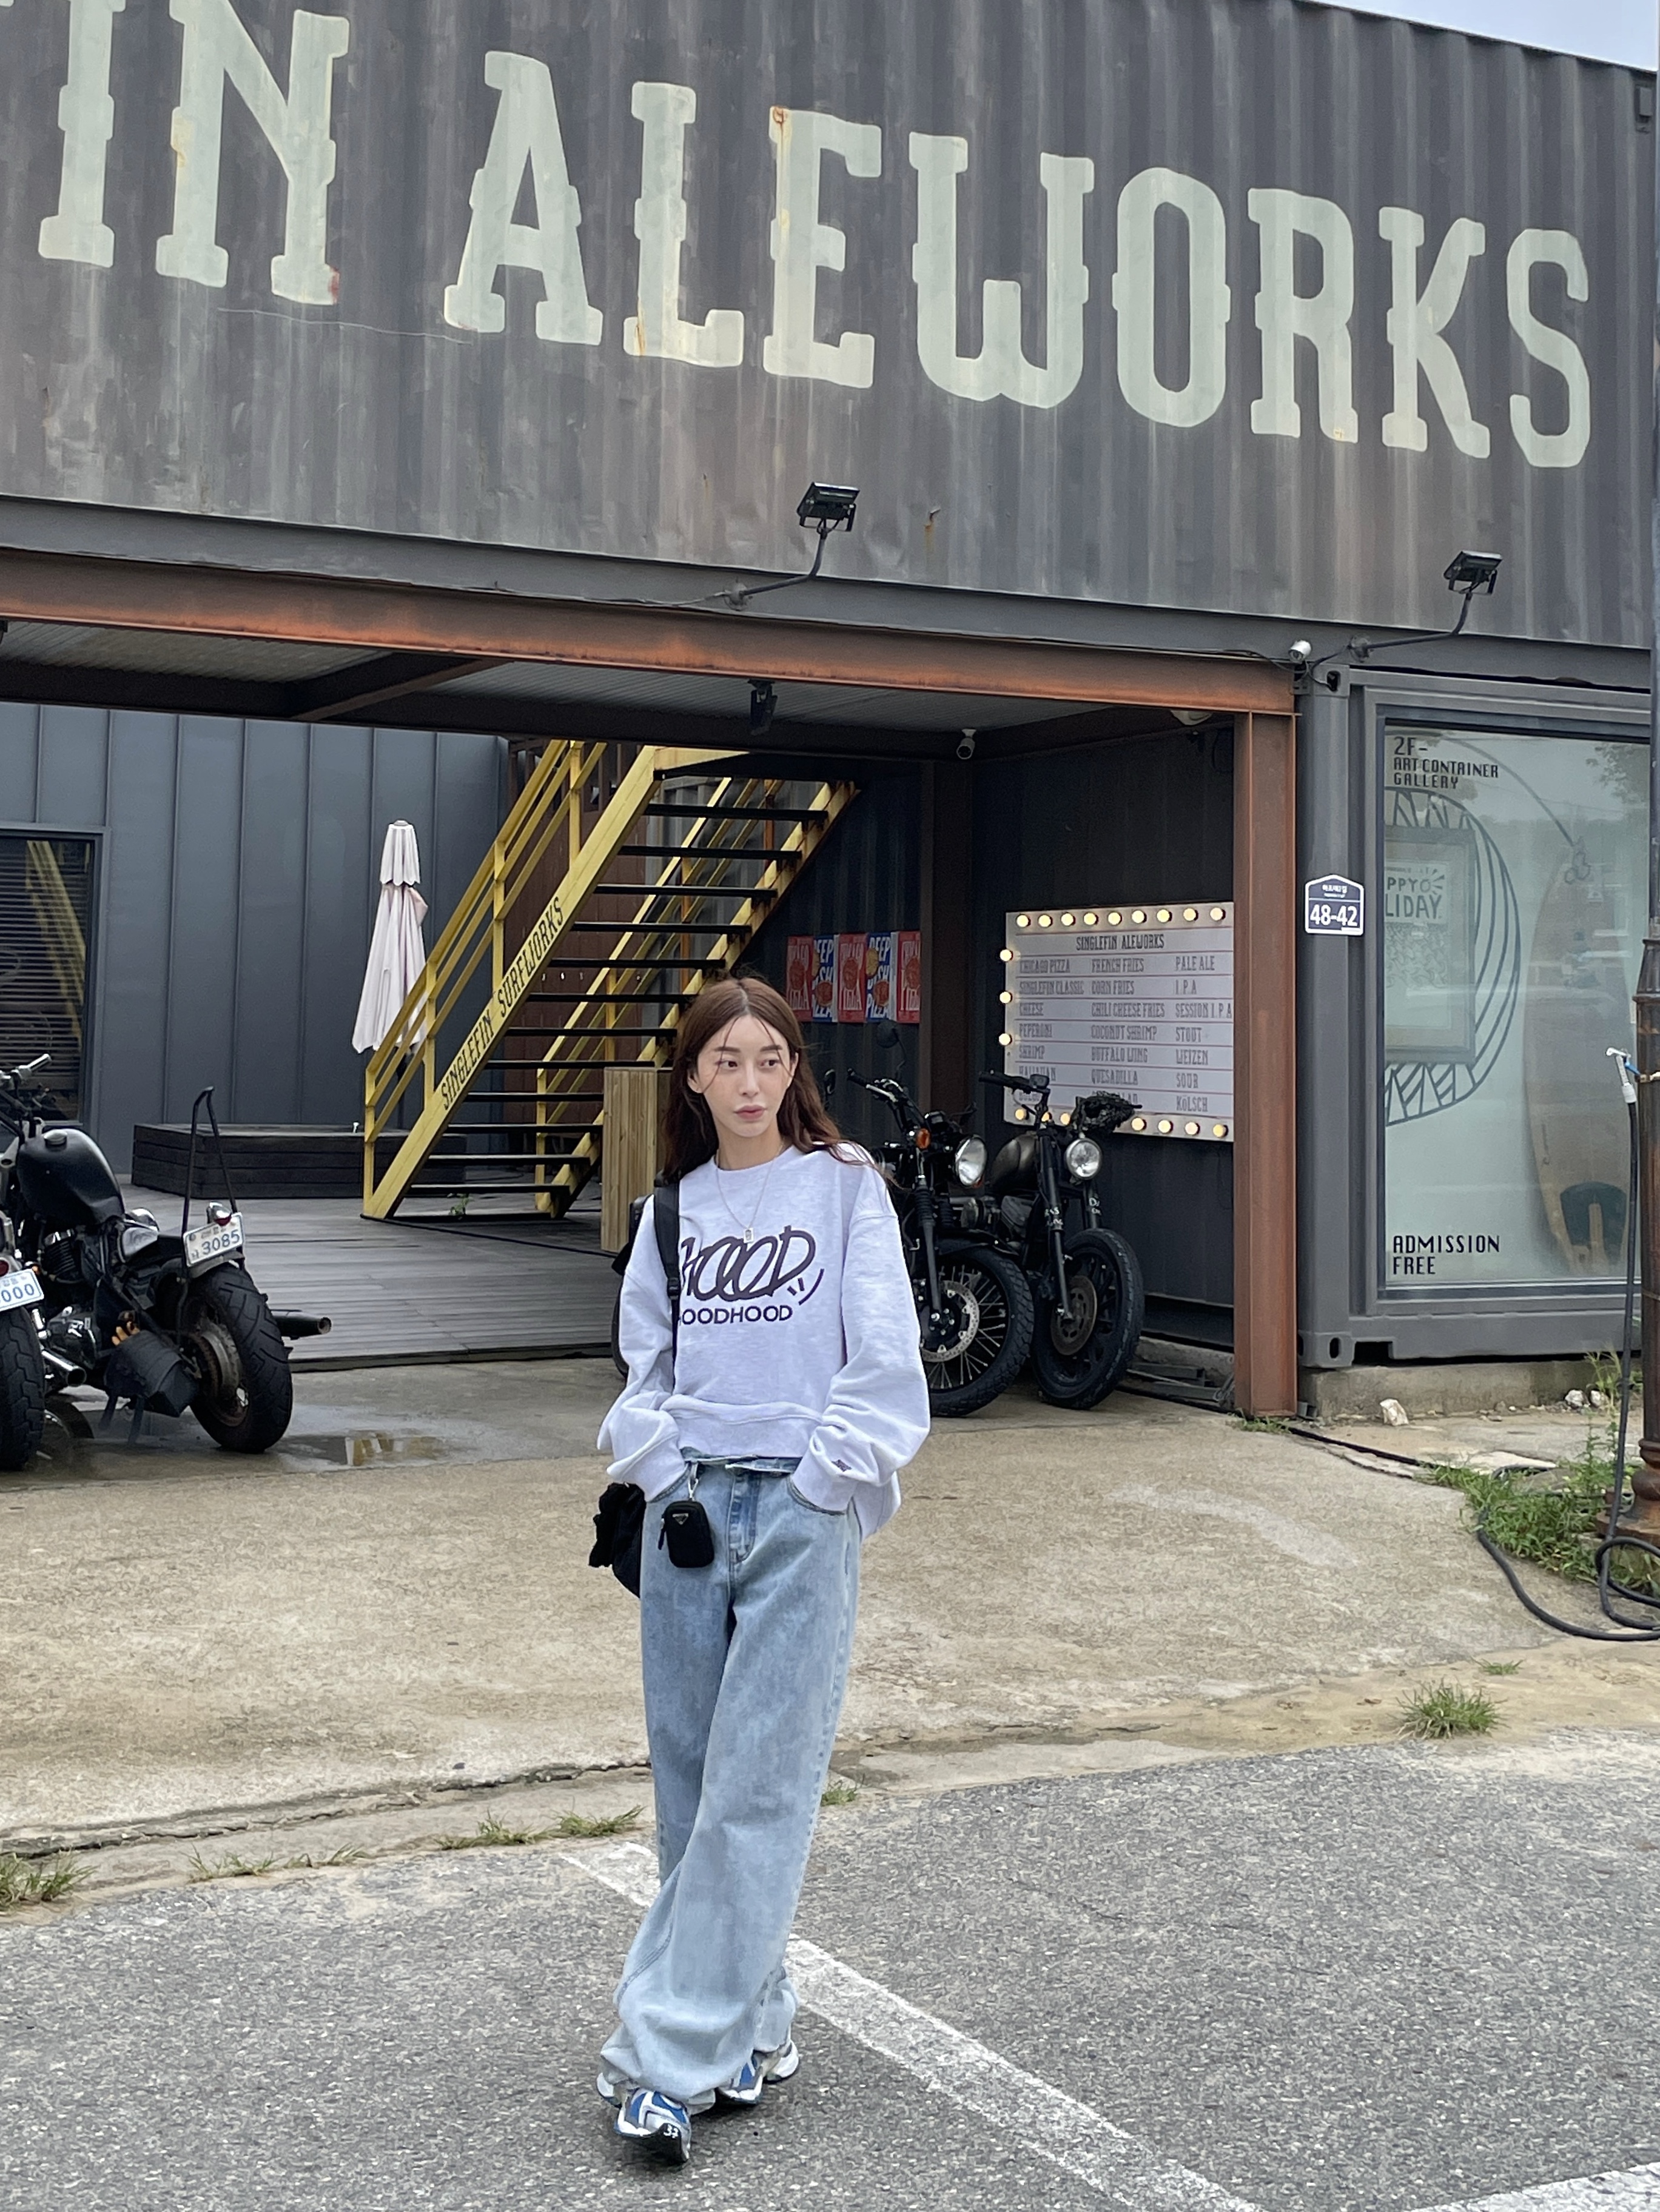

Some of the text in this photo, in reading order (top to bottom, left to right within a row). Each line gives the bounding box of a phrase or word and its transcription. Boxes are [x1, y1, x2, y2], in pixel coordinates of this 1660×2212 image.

[445, 51, 1590, 468] ALEWORKS
[1394, 757, 1499, 778] ART CONTAINER
[1394, 773, 1459, 789] GALLERY
[1310, 904, 1358, 927] 48-42
[1077, 934, 1164, 951] SINGLEFIN ALEWORKS
[1049, 959, 1070, 973] PIZZA
[1092, 957, 1144, 973] FRENCH FRIES
[1175, 956, 1215, 971] PALE ALE
[1055, 980, 1084, 994] CLASSIC
[1091, 980, 1135, 994] CORN FRIES
[441, 896, 563, 1110] SINGLEFIN SURFWORKS
[1019, 1002, 1044, 1016] CHEESE
[1091, 1003, 1165, 1017] CHILI CHEESE FRIES
[1175, 1004, 1209, 1018] SESSION
[1091, 1025, 1158, 1041] COCONUT SHRIMP
[1175, 1027, 1202, 1042] STOUT
[1019, 1046, 1045, 1059] SHRIMP
[1091, 1047, 1148, 1063] BUFFALO WING
[1175, 1050, 1208, 1065] WEIZEN
[1091, 1069, 1138, 1085] QUESADILLA
[1176, 1073, 1198, 1088] SOUR
[201, 1228, 240, 1256] 3085
[1393, 1235, 1500, 1253] ADMISSION
[1393, 1256, 1436, 1275] FREE
[679, 1304, 793, 1326] OODHOOD
